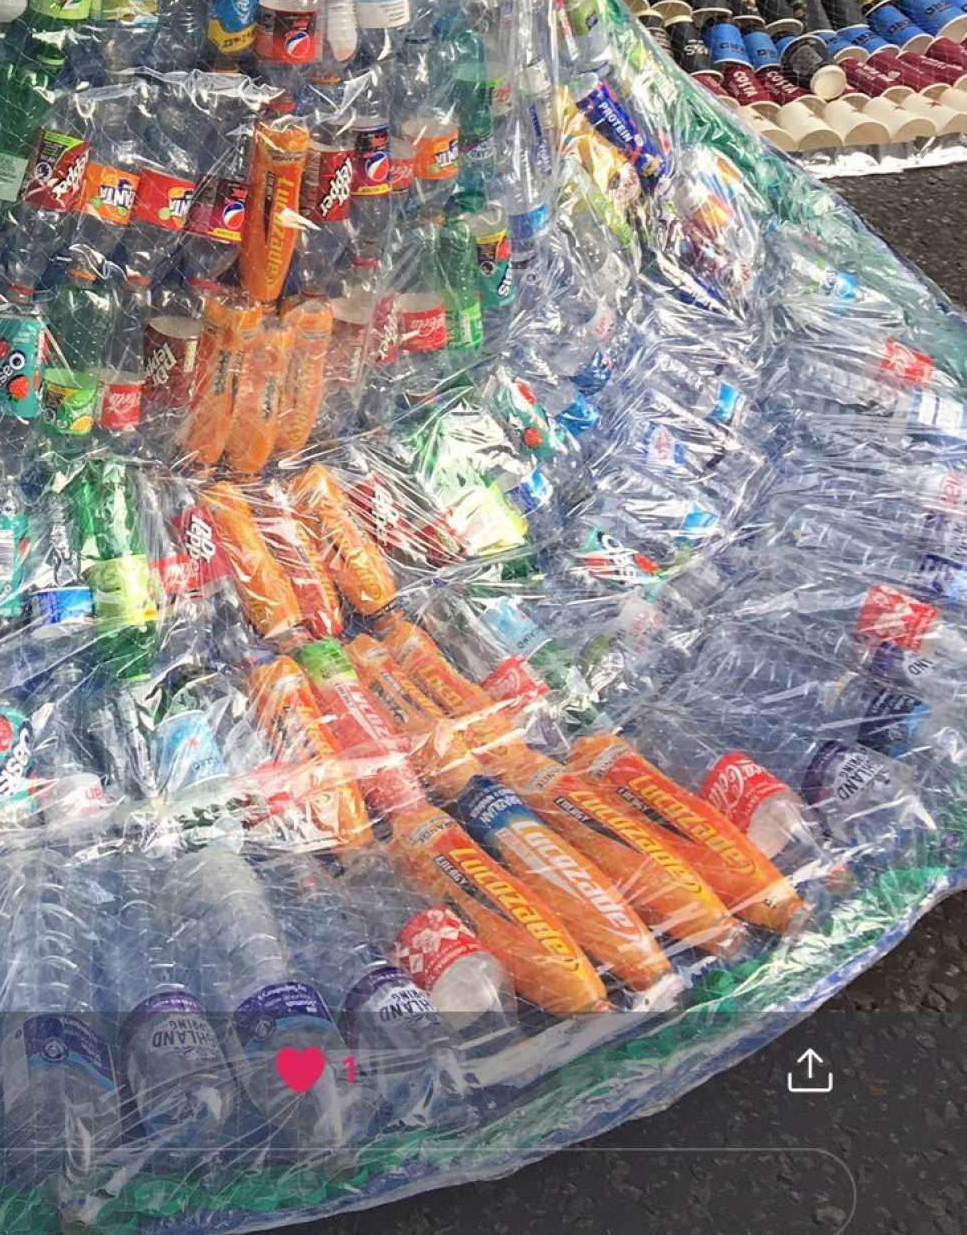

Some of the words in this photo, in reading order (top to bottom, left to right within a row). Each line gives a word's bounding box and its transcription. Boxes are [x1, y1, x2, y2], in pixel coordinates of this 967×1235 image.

[734, 71, 758, 98] COSTA
[766, 70, 800, 95] COSTA
[599, 101, 633, 143] PROTEIN
[556, 797, 589, 822] ENERGY
[626, 774, 745, 865] Lucozade
[567, 789, 697, 891] Lucozade
[437, 854, 467, 887] ENERGY
[512, 819, 634, 929] Lucozade
[448, 846, 575, 957] Lucozade
